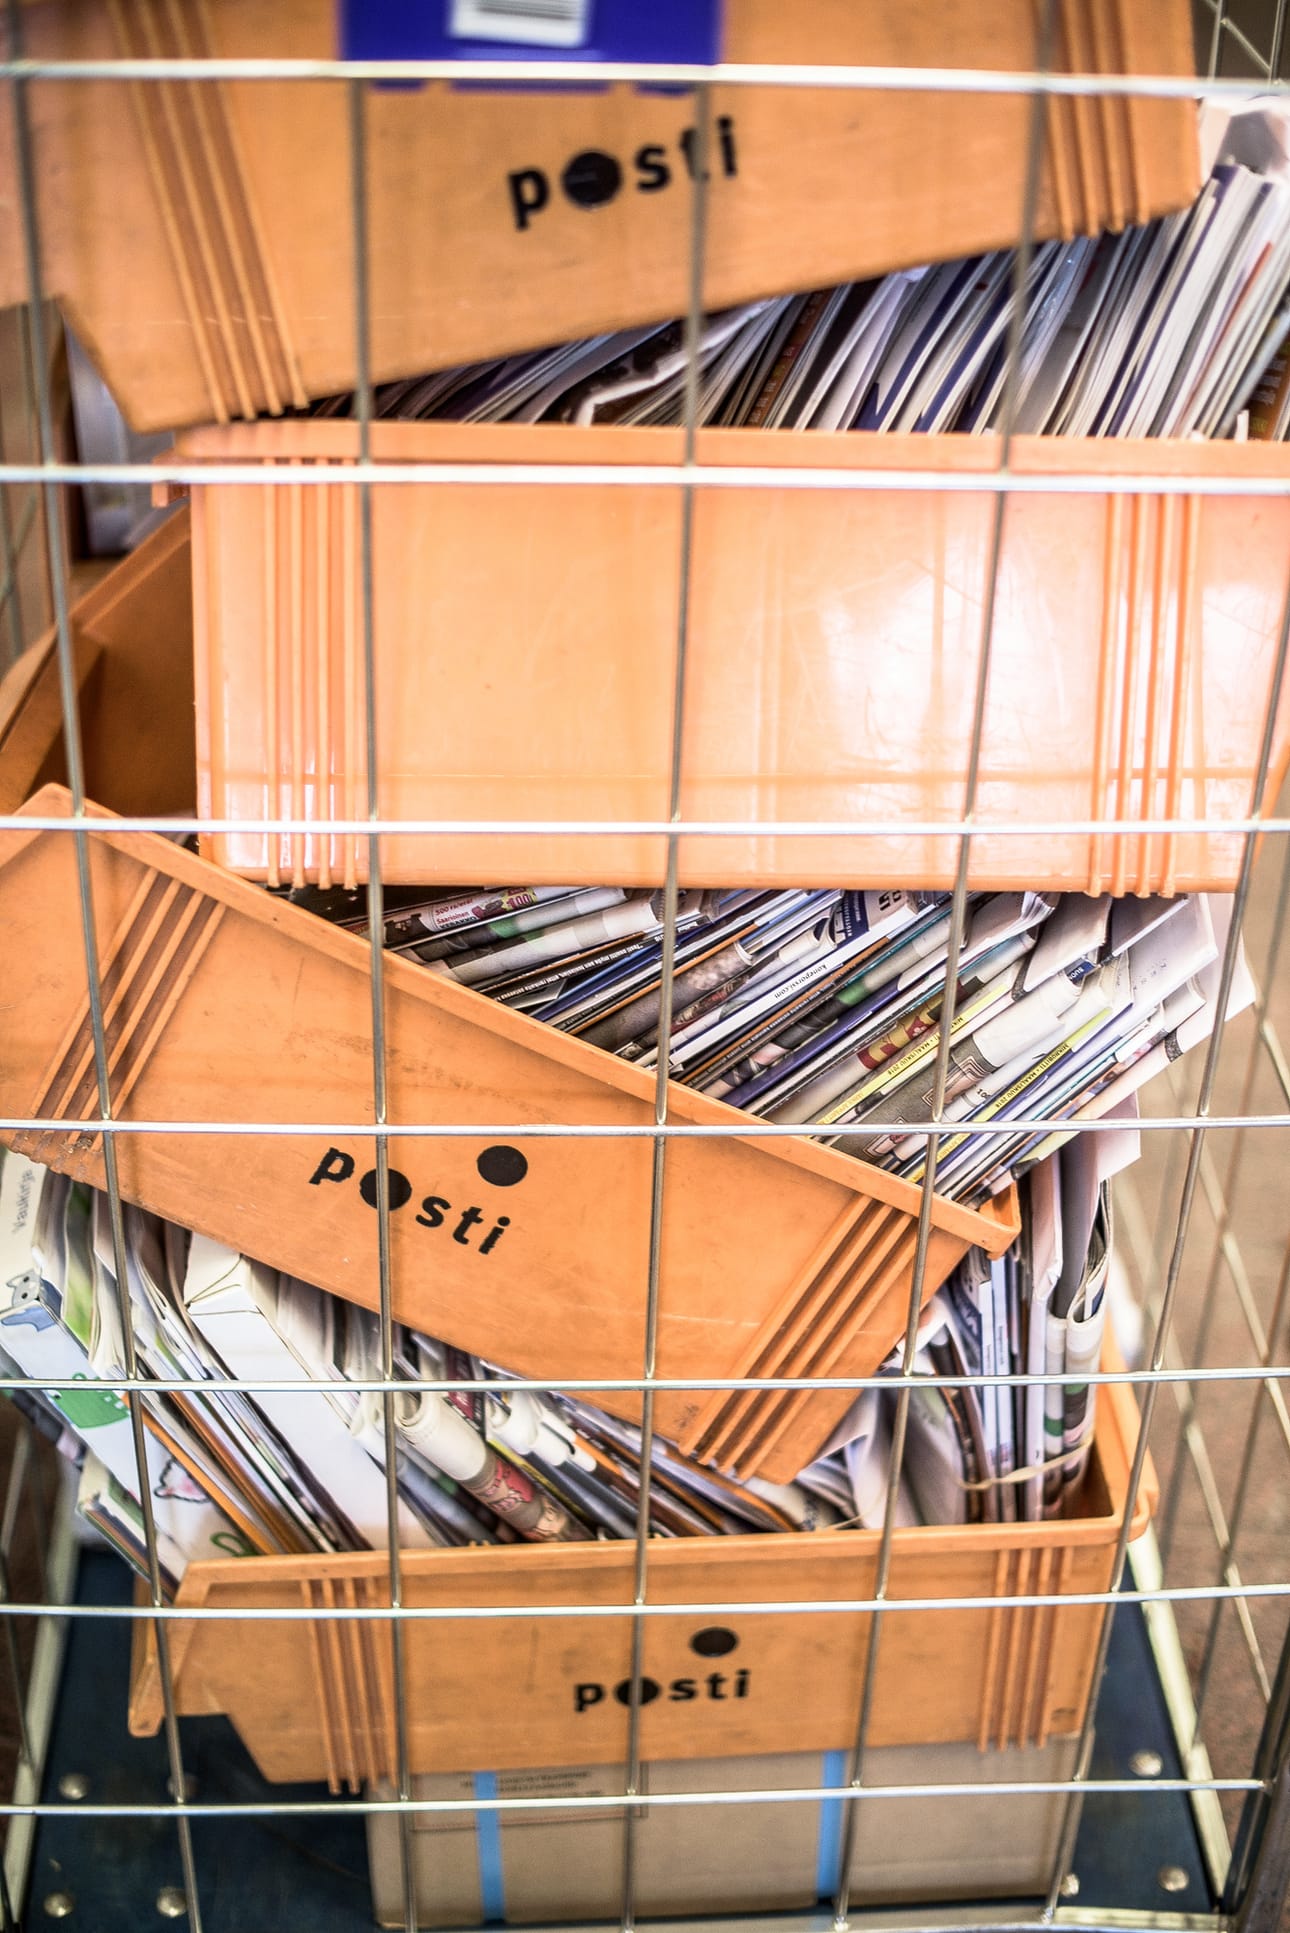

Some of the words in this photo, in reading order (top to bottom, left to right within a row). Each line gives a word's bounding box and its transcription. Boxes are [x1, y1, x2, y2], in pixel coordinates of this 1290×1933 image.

[508, 115, 739, 231] posti
[309, 1146, 511, 1255] posti
[573, 1668, 751, 1713] posti
